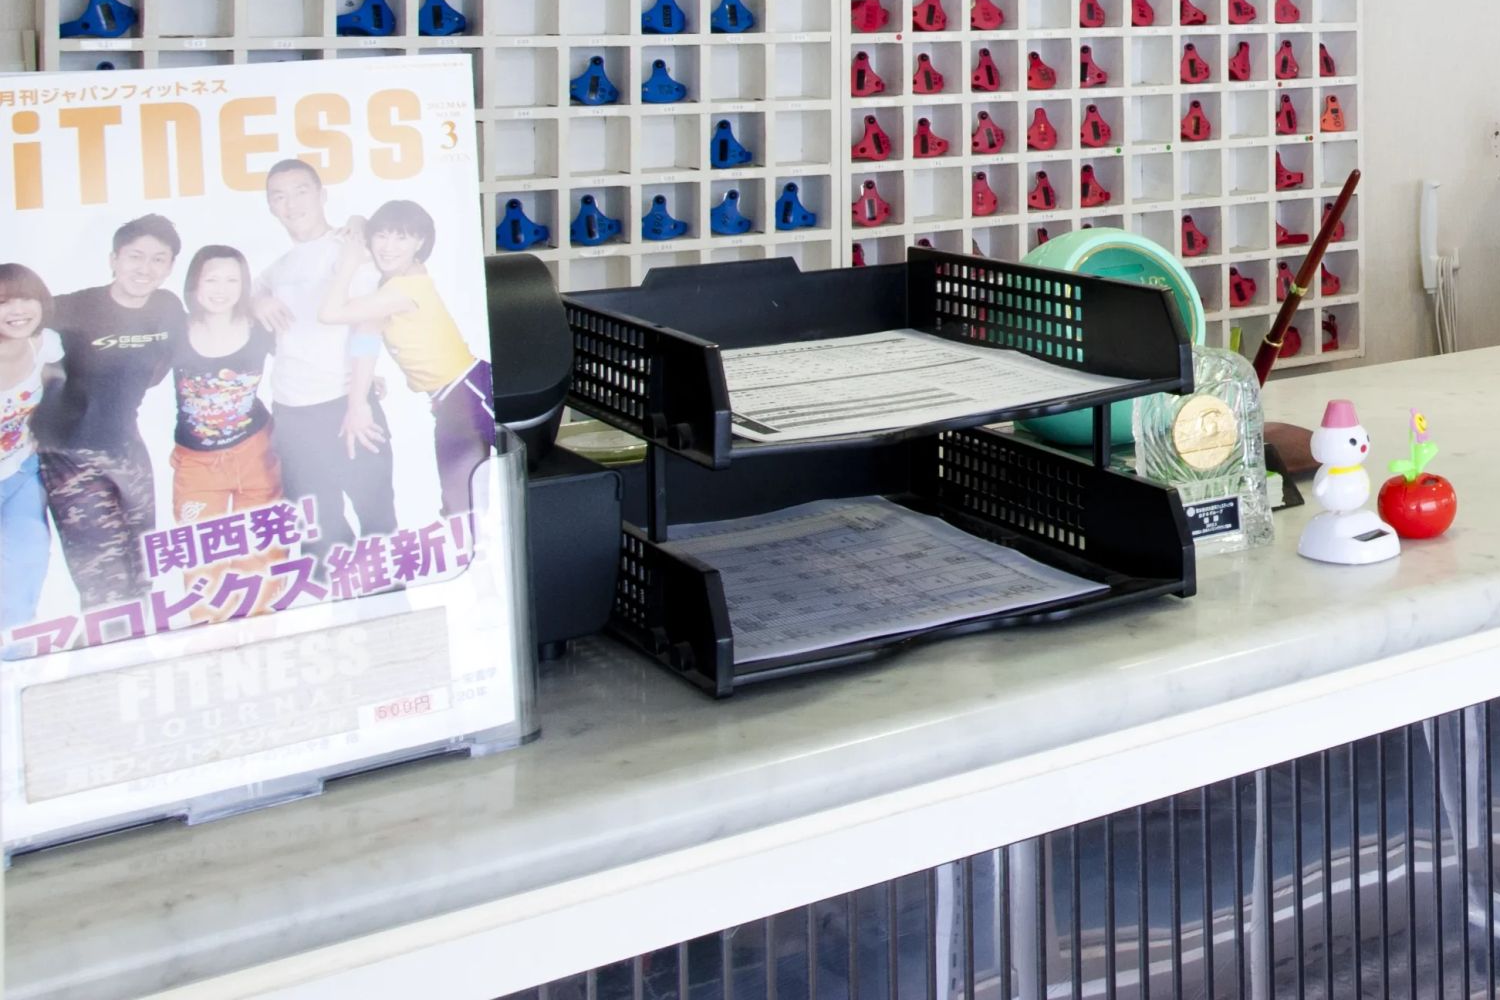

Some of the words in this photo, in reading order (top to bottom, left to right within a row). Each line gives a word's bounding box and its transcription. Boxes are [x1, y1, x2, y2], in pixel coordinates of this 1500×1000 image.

[0, 79, 229, 108] 月刊ジャパンフィットネス
[440, 120, 458, 150] 3
[144, 497, 320, 578] 関西発!
